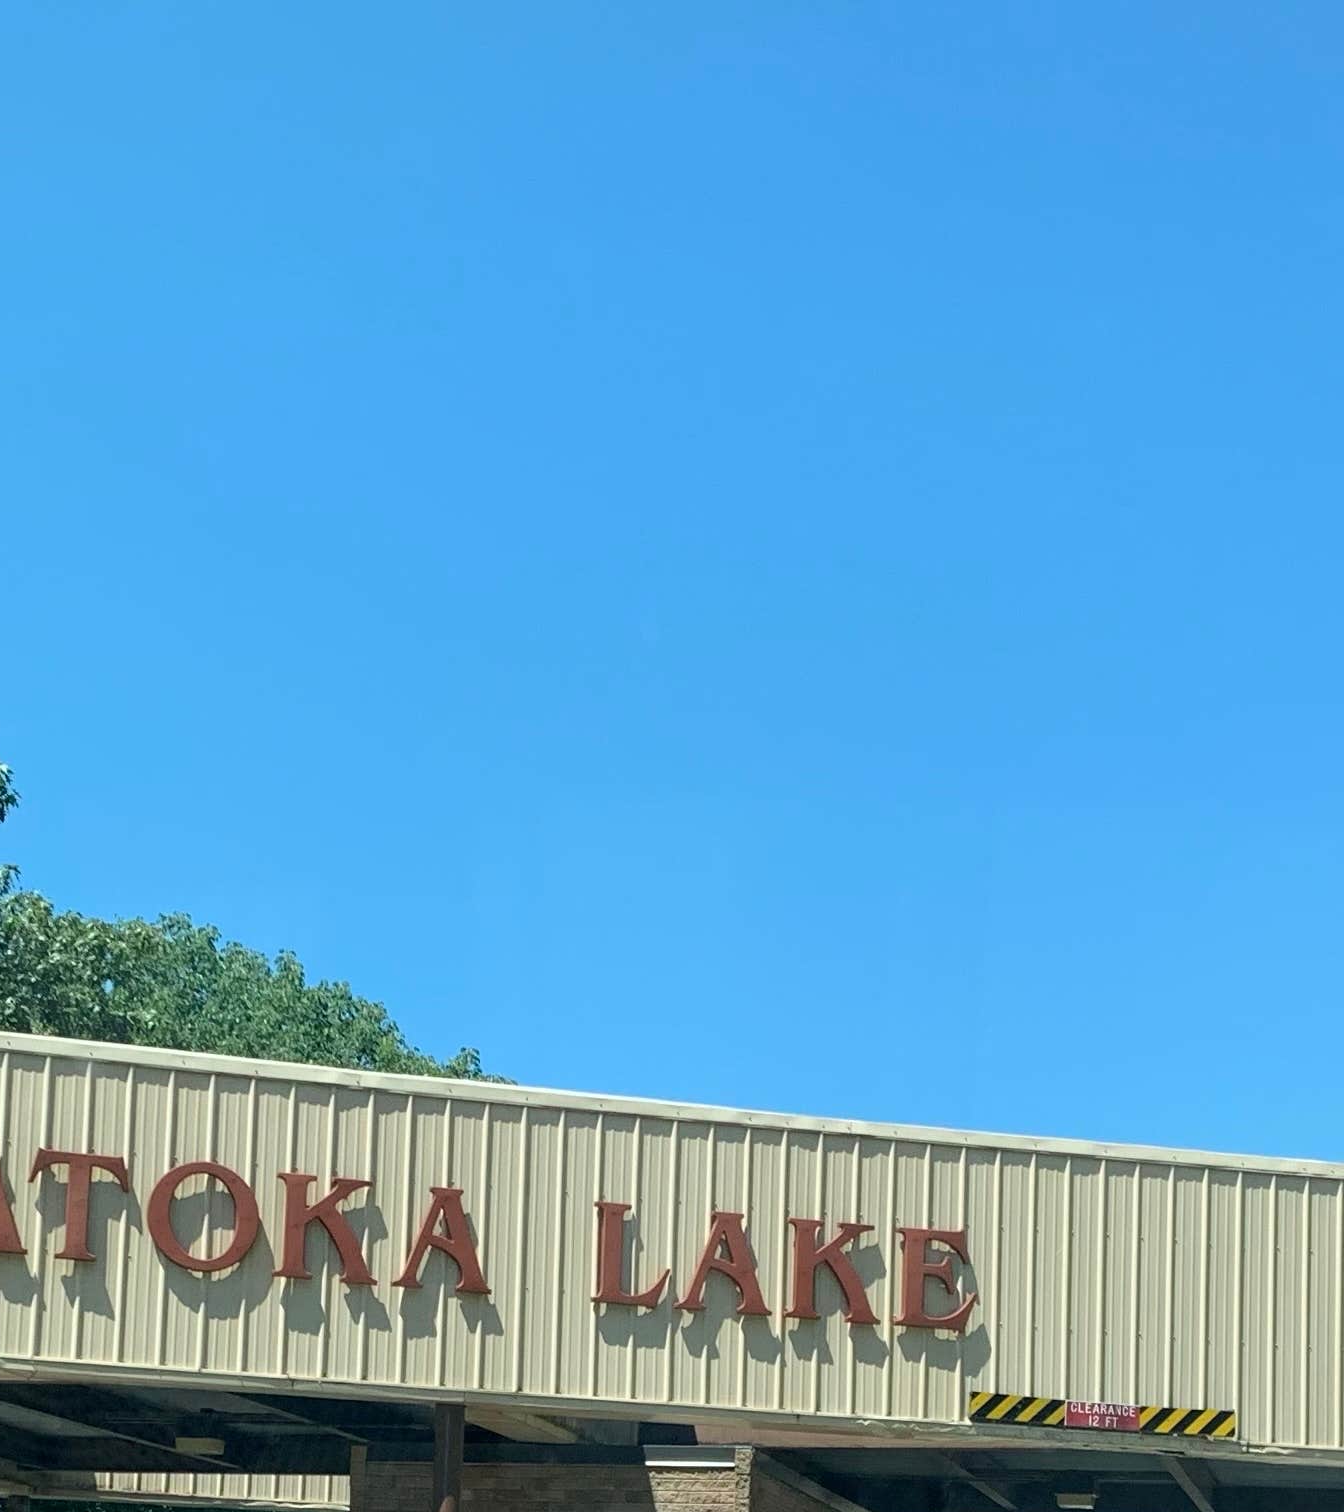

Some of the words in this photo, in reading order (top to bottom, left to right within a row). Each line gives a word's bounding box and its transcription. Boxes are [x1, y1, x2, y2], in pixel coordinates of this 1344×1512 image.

[591, 1201, 979, 1333] LAKE
[1070, 1402, 1136, 1418] CLEARANCE
[1088, 1415, 1100, 1427] 12
[1105, 1416, 1119, 1428] FT
